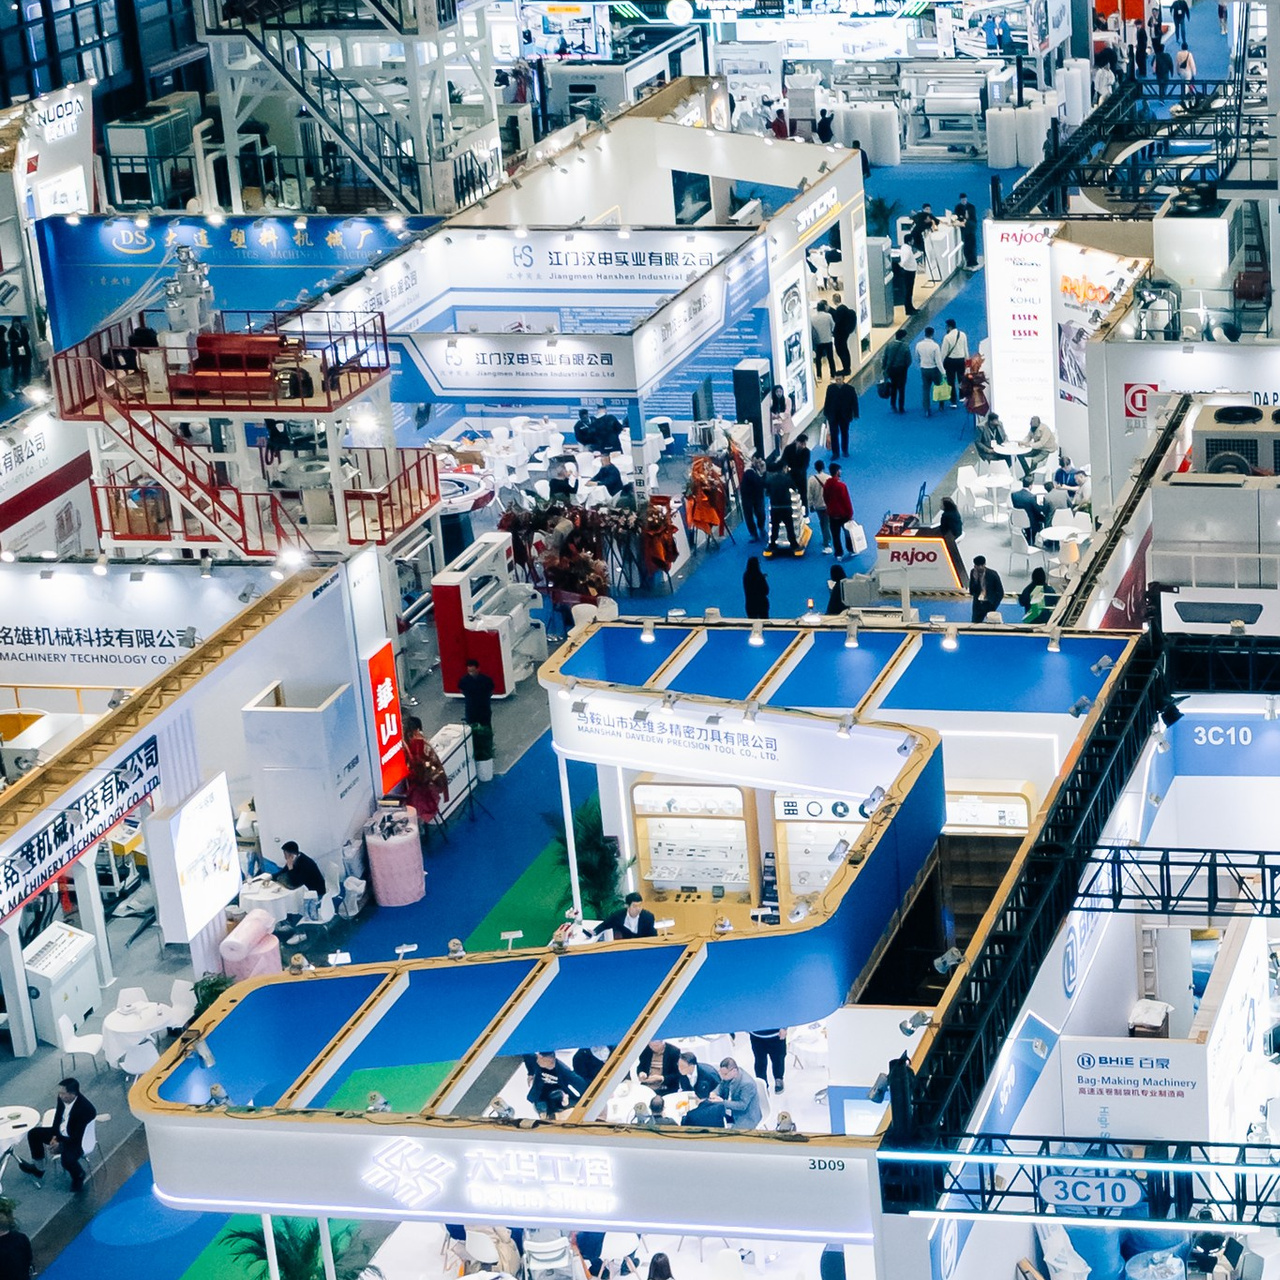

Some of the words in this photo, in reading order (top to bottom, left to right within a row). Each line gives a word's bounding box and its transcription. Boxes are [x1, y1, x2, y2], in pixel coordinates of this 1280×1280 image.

[37, 98, 84, 127] NUODA
[120, 229, 148, 246] DS
[548, 251, 713, 267] 江门汉申实业有限公司
[548, 273, 593, 281] Jiangmen
[596, 272, 634, 280] Hanshen
[638, 272, 683, 280] Industrial
[1010, 297, 1041, 305] KOHLI
[1012, 329, 1039, 337] ESSEN
[475, 352, 614, 366] 江门汉申实业有限公司
[476, 371, 513, 379] Jiangmen
[515, 370, 548, 378] Hanshen
[550, 370, 587, 378] Industrial
[3, 432, 46, 472] 有限公司
[0, 652, 67, 662] MACHINERY
[70, 652, 147, 664] TECHNOLOGY
[576, 711, 779, 753] 马鞍山市达维多精密刀具有限公司
[1193, 725, 1252, 746] 3C10
[577, 724, 623, 739] MAANSHAN
[625, 732, 665, 745] DAVEDEW
[666, 737, 712, 752] PRECISION
[714, 745, 738, 757] TOOL
[7, 856, 64, 911] MACHINERY
[65, 804, 126, 862] TECHNOLOGY
[1077, 1075, 1140, 1088] Bag-Making
[1142, 1077, 1197, 1090] Machinery
[1078, 1087, 1185, 1099] 高速连卷制袋机专业制造商
[1097, 1106, 1110, 1129] High
[464, 1151, 613, 1188] 大华工控
[809, 1158, 846, 1171] 3D09
[1054, 1180, 1127, 1203] 3C10
